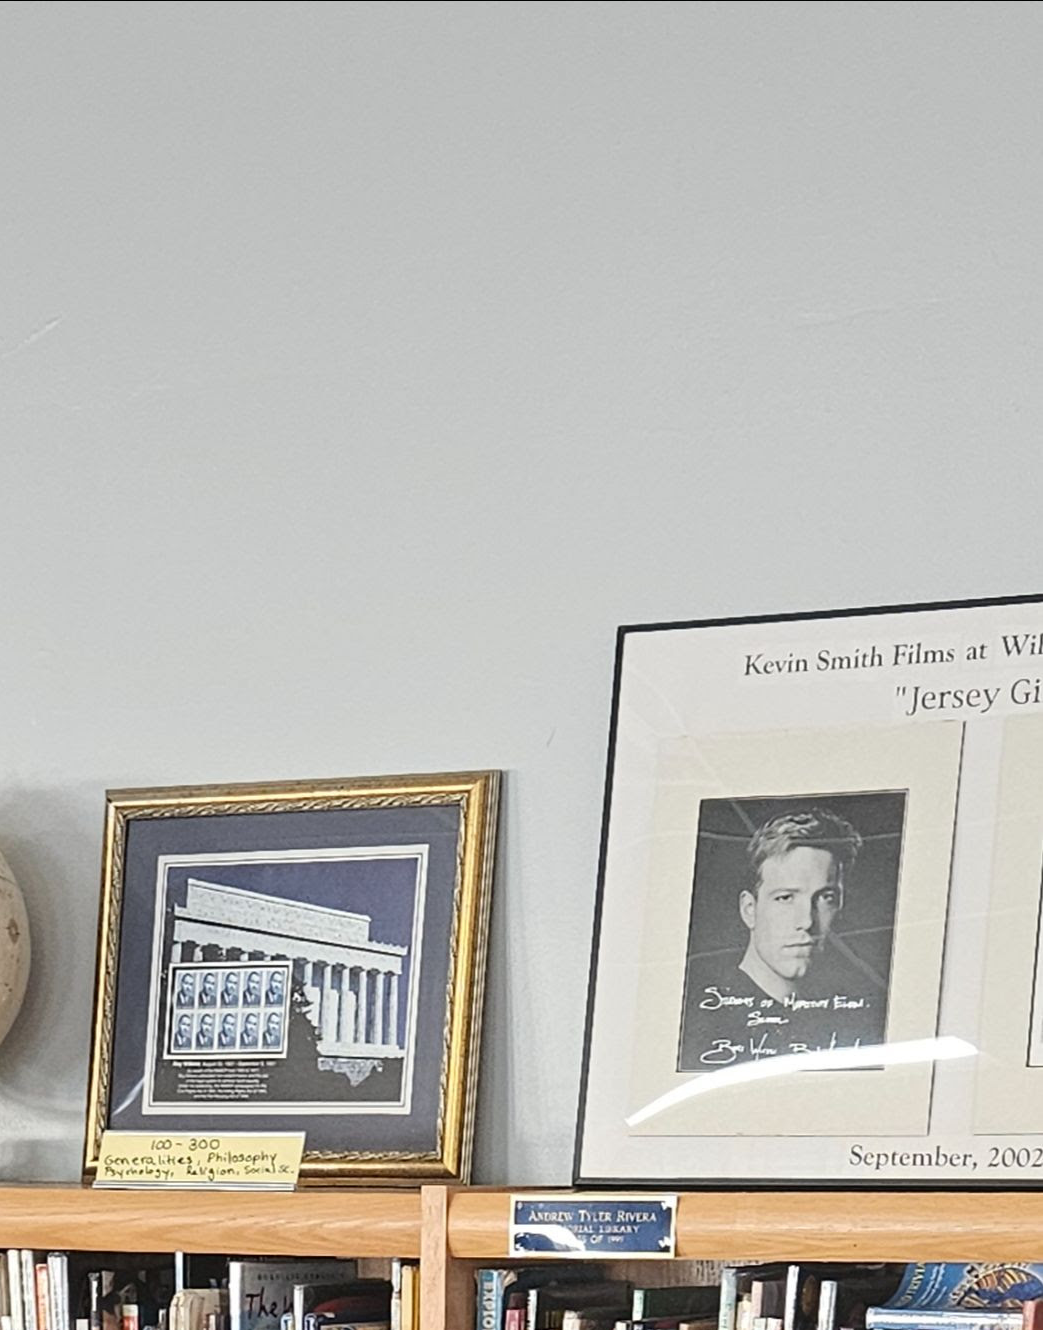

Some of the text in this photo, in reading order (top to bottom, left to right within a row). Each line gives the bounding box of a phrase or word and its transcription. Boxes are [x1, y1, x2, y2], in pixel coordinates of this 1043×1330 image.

[744, 653, 808, 676] Kevin
[816, 646, 883, 671] Smith
[892, 643, 955, 666] Films
[966, 643, 988, 660] at
[896, 686, 1001, 716] "Jersey
[151, 1139, 172, 1150] 100
[188, 1138, 220, 1150] 300
[850, 1144, 1043, 1171] September, 2002
[207, 1152, 277, 1168] Philosophy
[528, 1210, 657, 1222] ANDREW TYLER RIVERA
[246, 1286, 277, 1319] The
